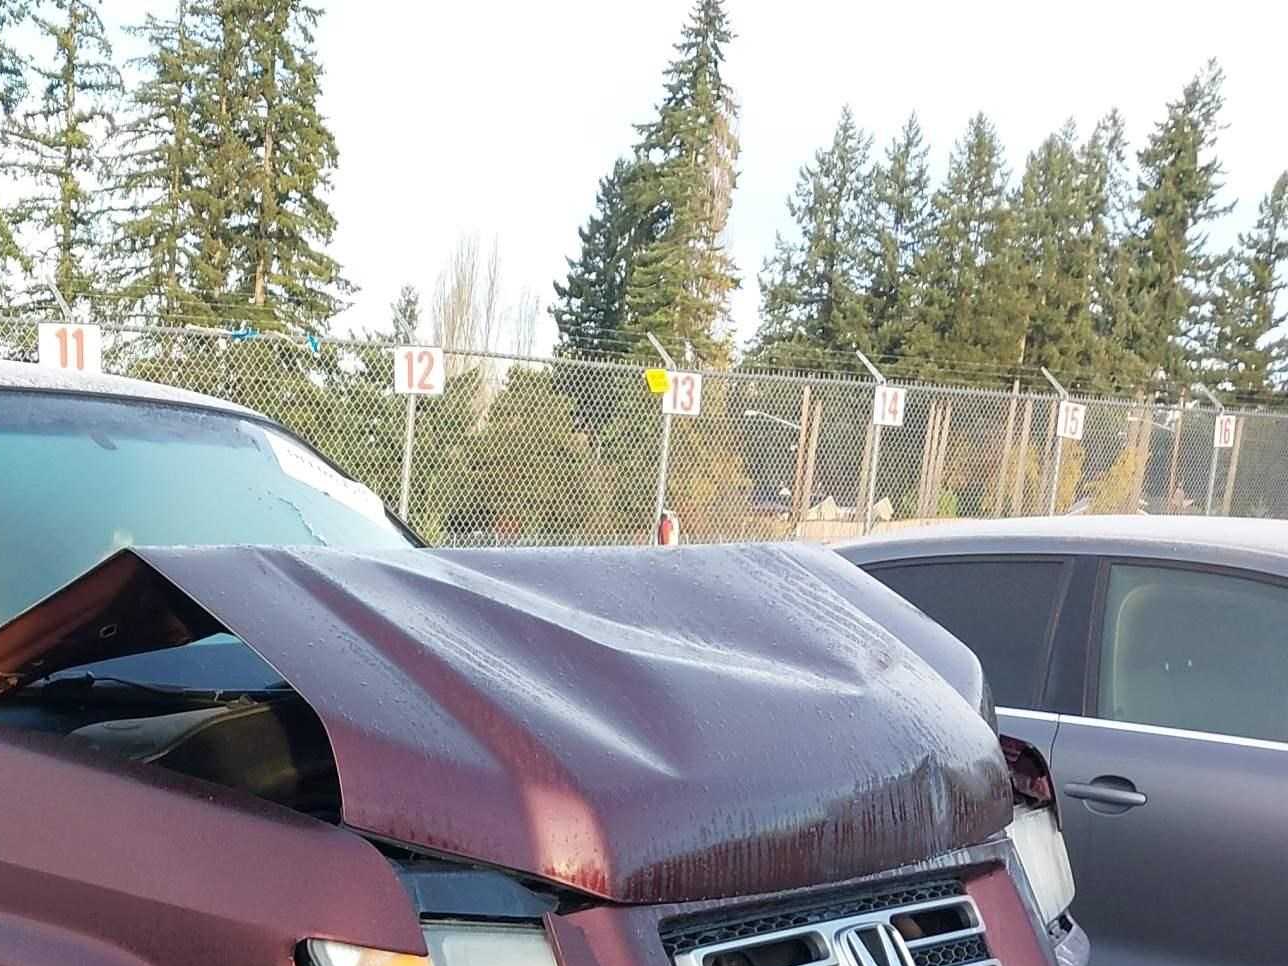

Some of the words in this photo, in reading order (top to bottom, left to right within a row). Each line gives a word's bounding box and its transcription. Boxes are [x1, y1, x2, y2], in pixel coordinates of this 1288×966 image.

[55, 327, 84, 370] 11
[403, 350, 434, 390] 12
[672, 375, 695, 412] 13
[881, 390, 898, 422] 14
[1063, 405, 1080, 435] 15
